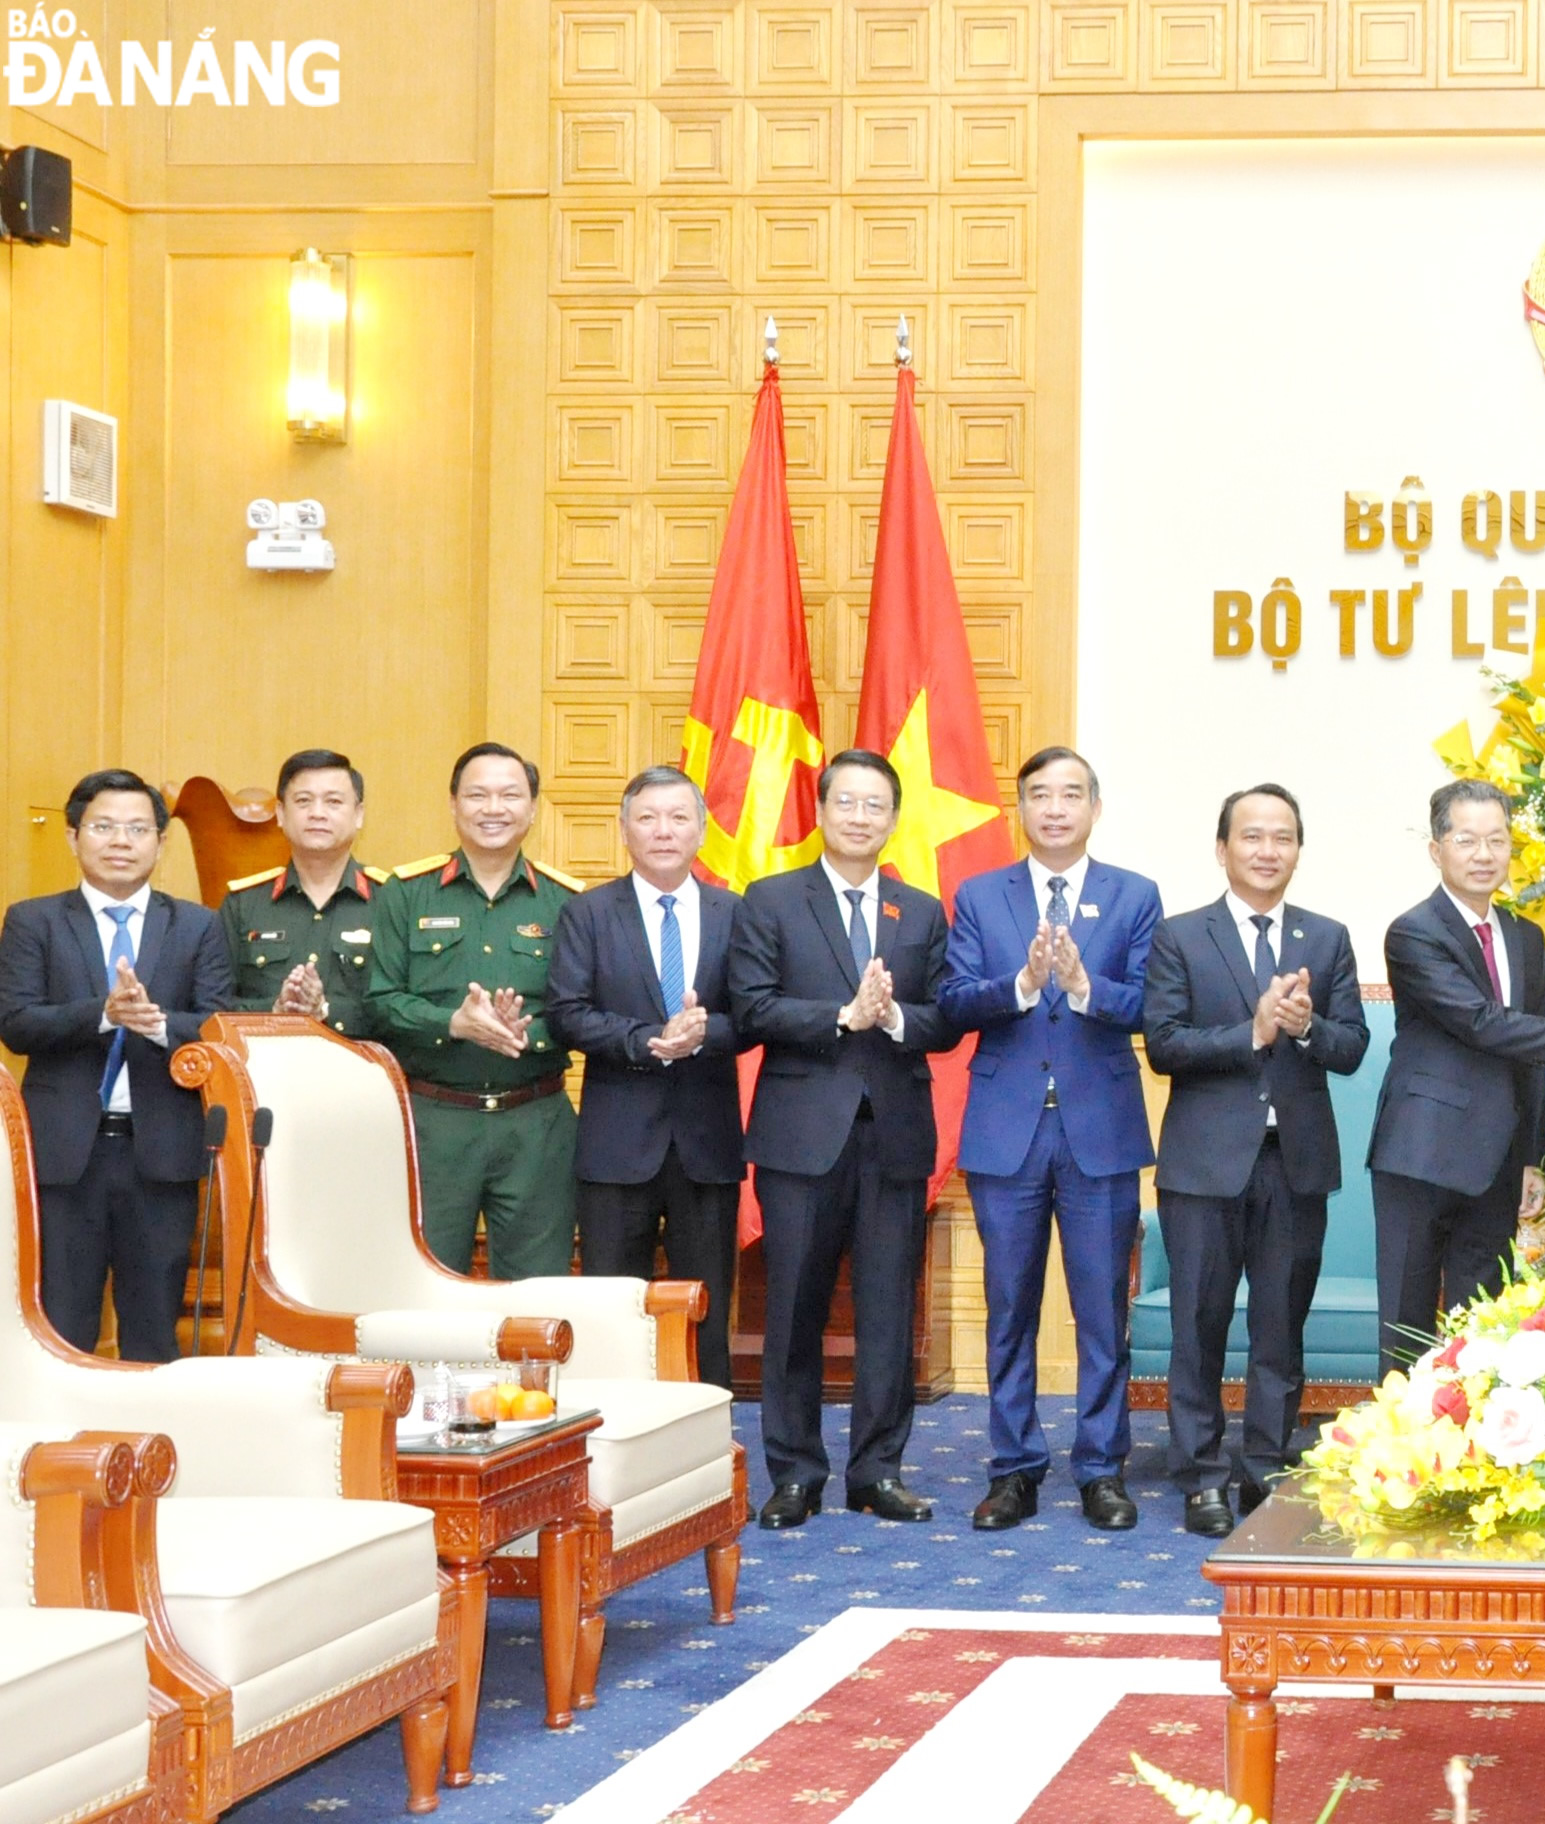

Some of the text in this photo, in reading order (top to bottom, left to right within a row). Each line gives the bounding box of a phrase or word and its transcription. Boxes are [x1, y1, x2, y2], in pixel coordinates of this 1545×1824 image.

[1344, 475, 1433, 566] BỘ
[1213, 577, 1302, 671] BỘ
[1329, 581, 1424, 657] TƯ
